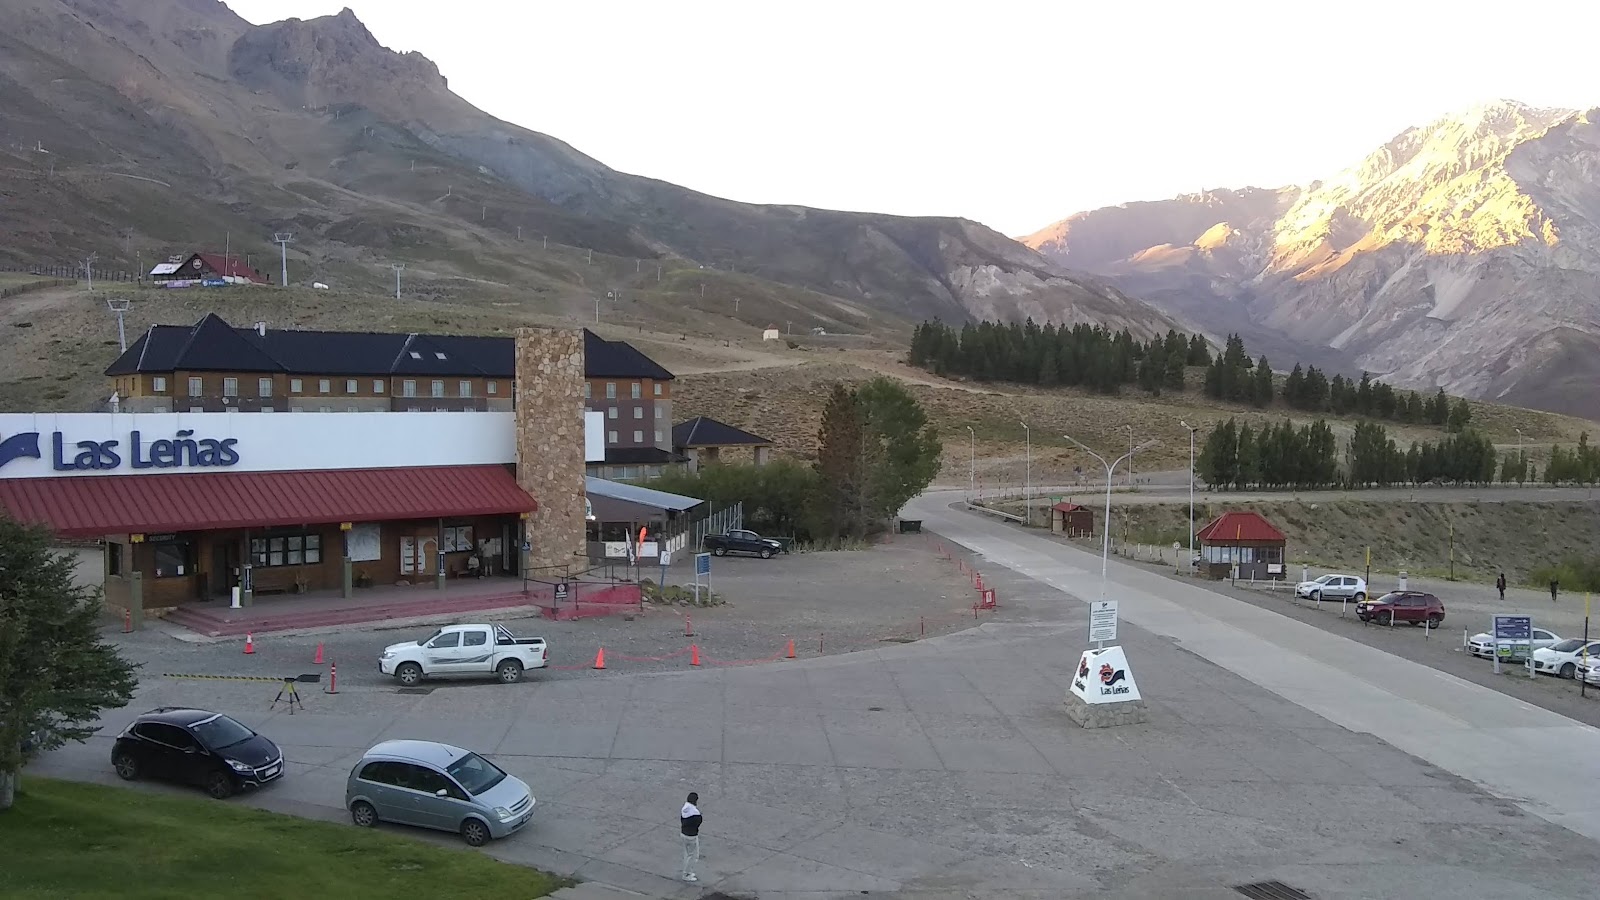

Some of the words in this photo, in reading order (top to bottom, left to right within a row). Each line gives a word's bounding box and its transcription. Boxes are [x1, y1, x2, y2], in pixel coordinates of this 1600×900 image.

[52, 431, 121, 471] Las
[130, 429, 240, 469] Leñas
[1100, 686, 1112, 695] Las
[1112, 685, 1130, 695] Leñas
